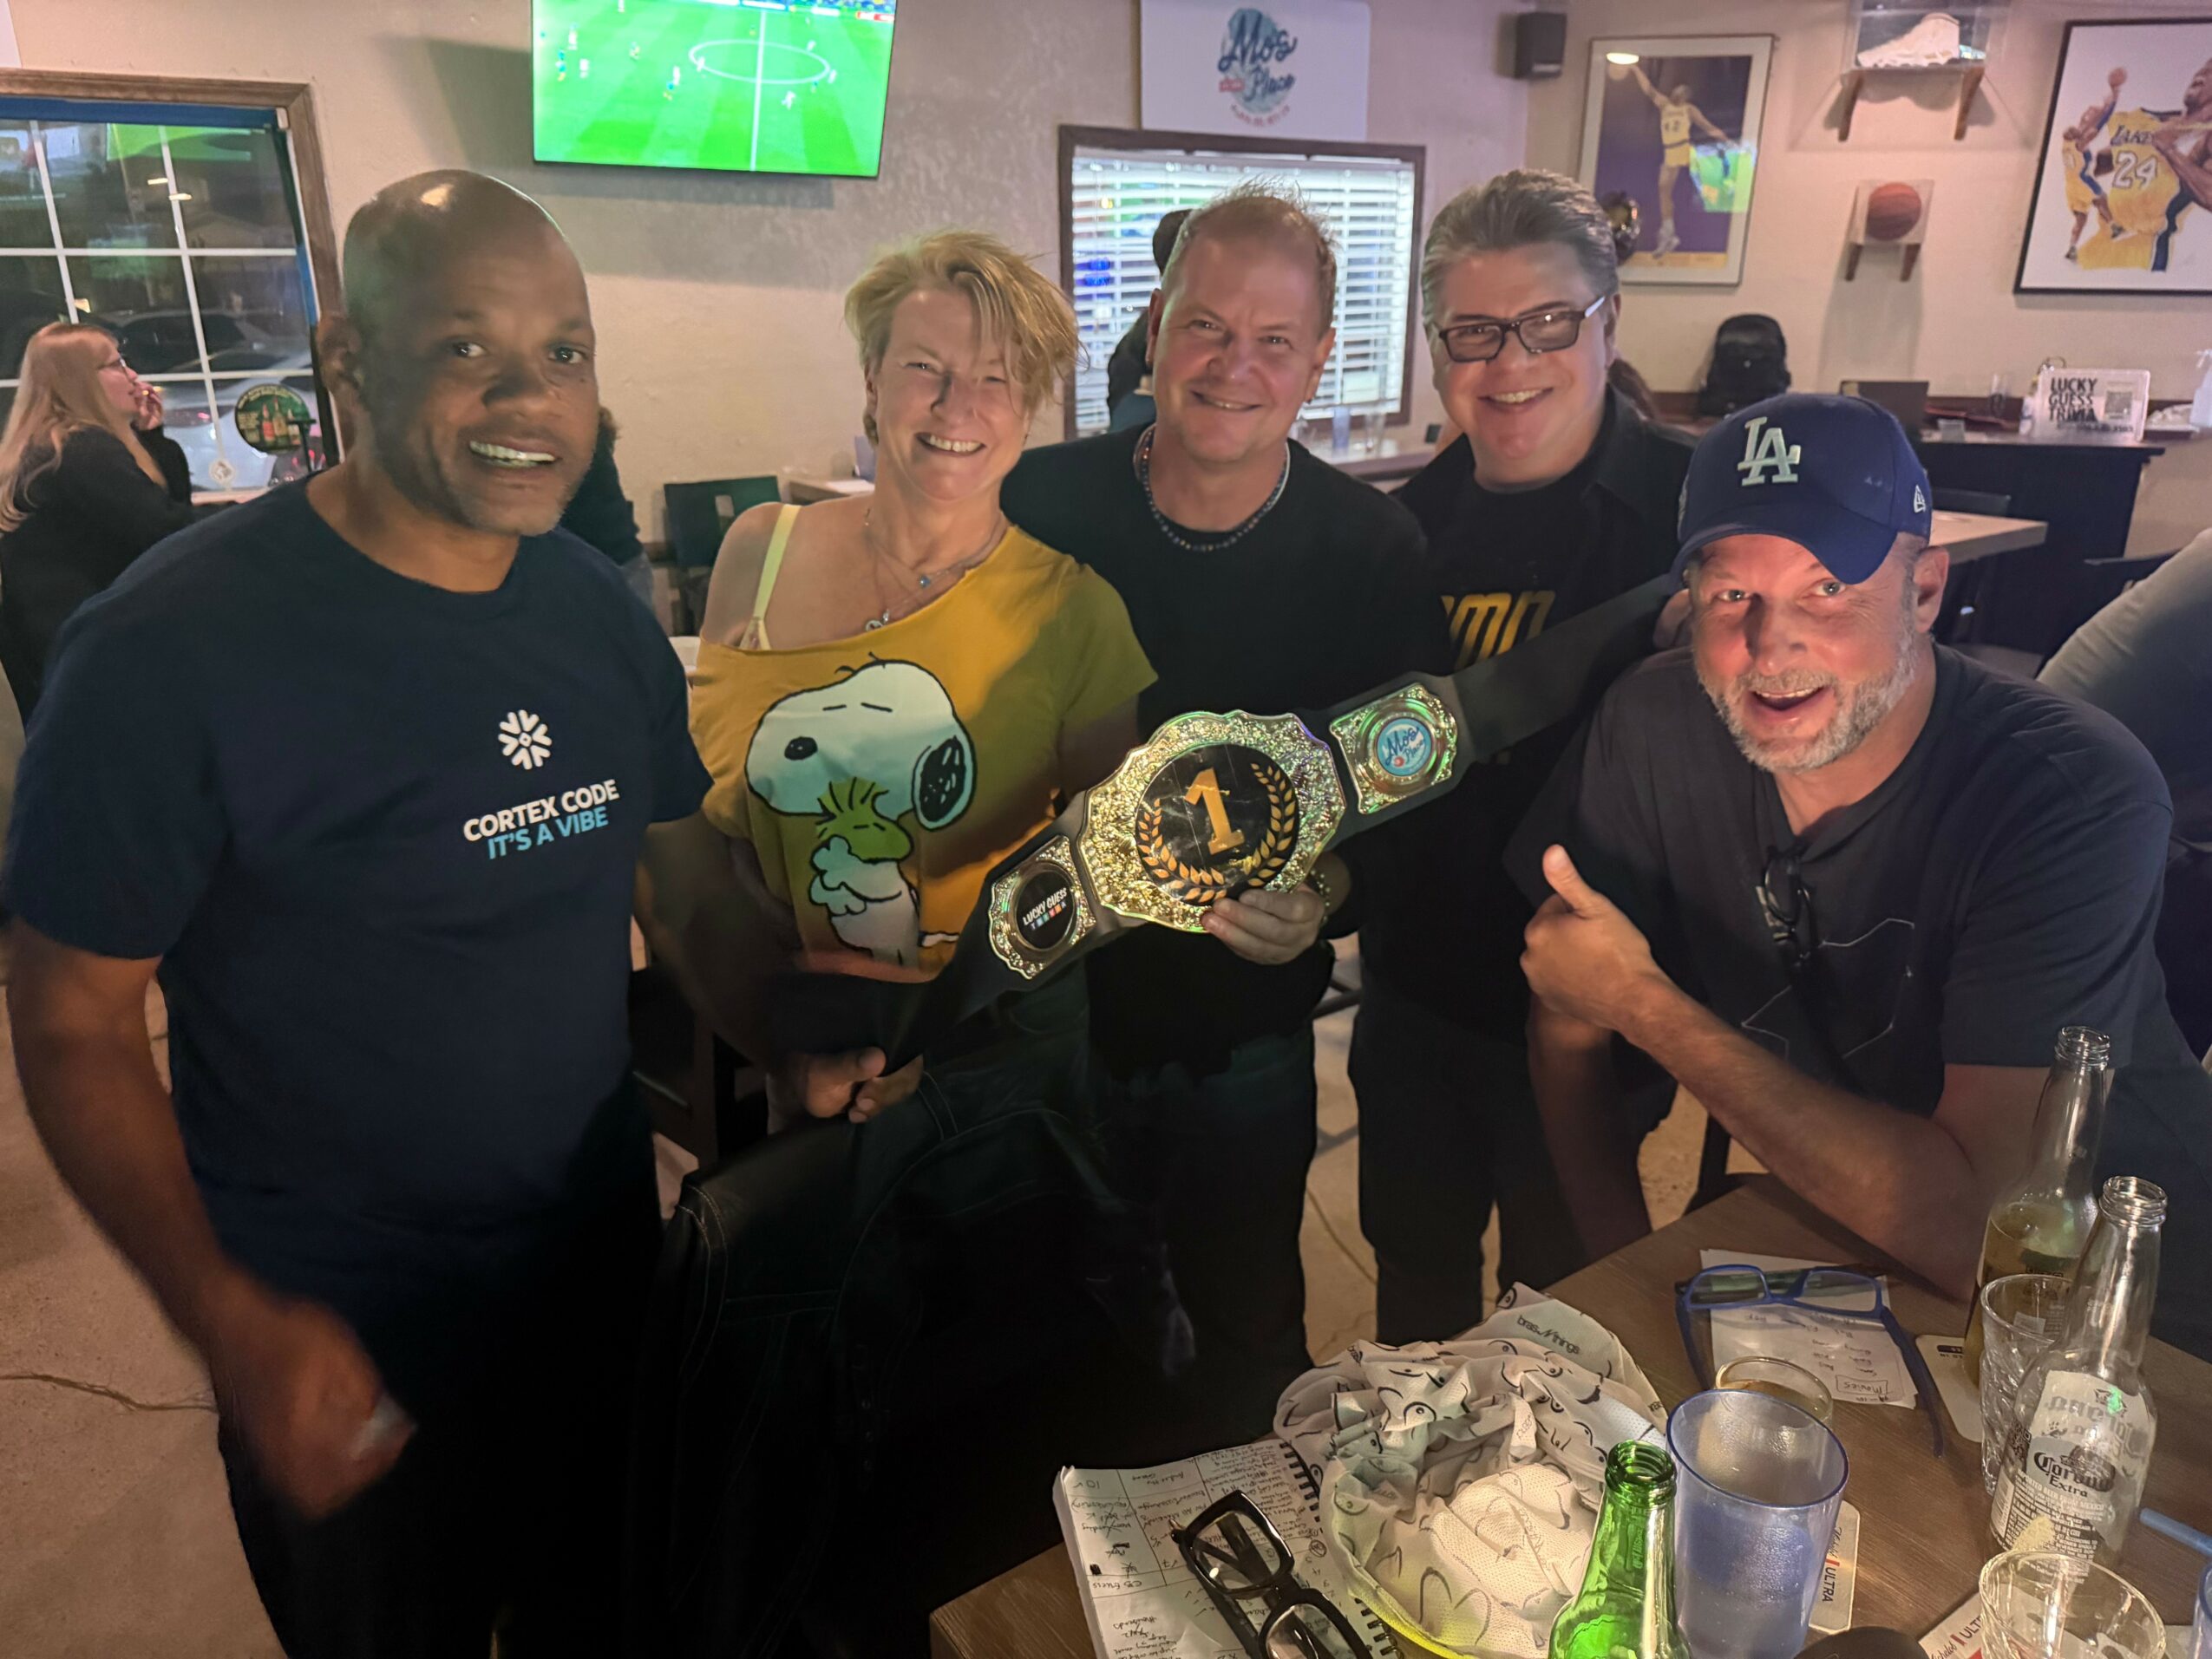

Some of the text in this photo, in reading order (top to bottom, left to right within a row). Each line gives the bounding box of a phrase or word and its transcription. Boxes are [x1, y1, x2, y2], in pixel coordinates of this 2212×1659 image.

[2112, 150, 2158, 189] 24
[2048, 392, 2094, 408] GUESS
[2051, 377, 2098, 395] LUCKY
[1738, 416, 1801, 487] LA
[463, 779, 620, 842] CORTEX CODE
[1183, 767, 1246, 855] 1
[488, 806, 609, 859] IT'S A VIBE
[1022, 887, 1067, 926] LUCKY GUESS
[1843, 1381, 1883, 1397] Movies
[1086, 1479, 1100, 1489] 10
[2048, 1473, 2089, 1498] Extra
[1822, 1566, 1836, 1603] ULTRA
[1929, 1640, 1958, 1659] ichelob
